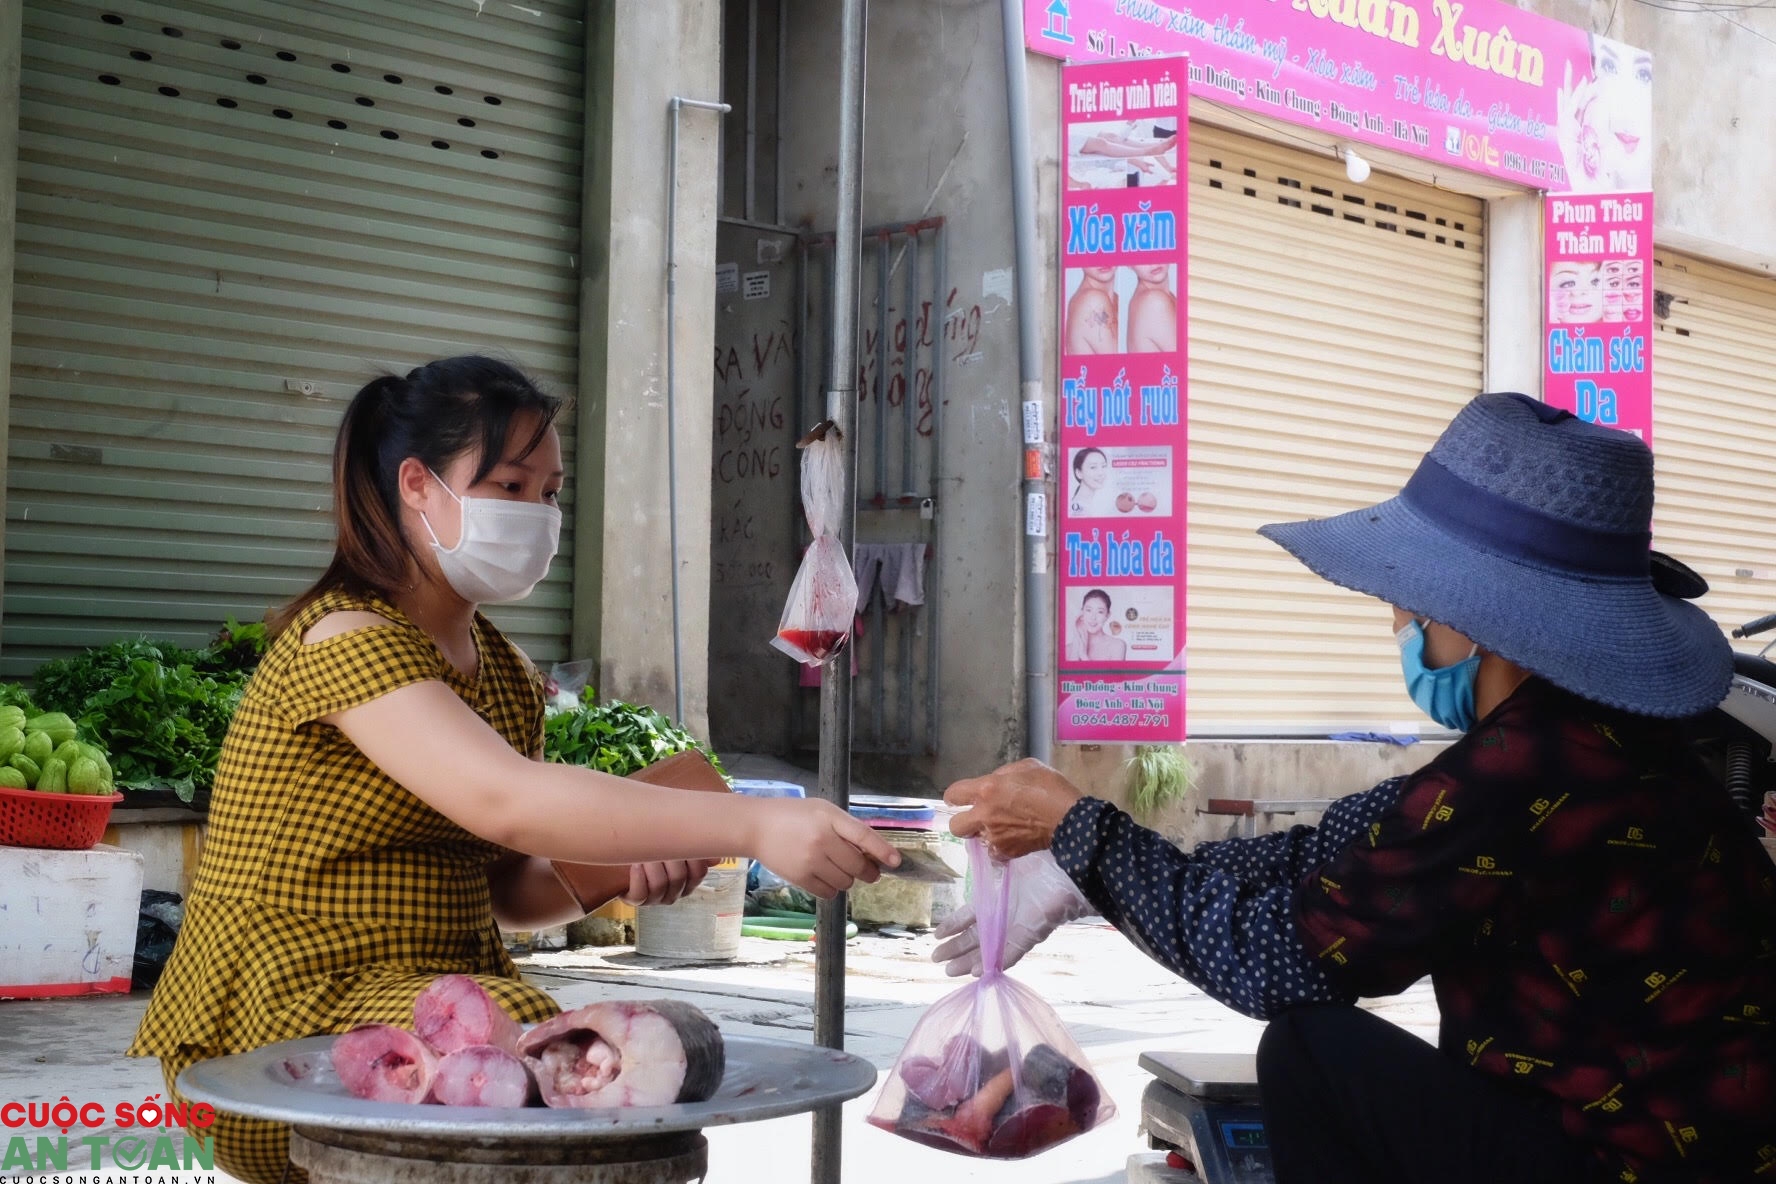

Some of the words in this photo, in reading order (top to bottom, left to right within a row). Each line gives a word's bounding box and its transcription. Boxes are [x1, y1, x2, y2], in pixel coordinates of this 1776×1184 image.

[1088, 30, 1105, 53] Số
[1167, 7, 1208, 39] xăm
[1213, 14, 1256, 54] thẩm
[1262, 37, 1287, 77] mỹ
[1305, 48, 1337, 79] Xóa
[1340, 61, 1377, 91] xăm
[1430, 0, 1544, 87] Xuân
[1069, 82, 1097, 118] Triệt
[1100, 81, 1124, 116] lông
[1256, 80, 1281, 104] Kim
[1284, 88, 1321, 118] Chung
[1364, 110, 1385, 133] Anh
[1394, 119, 1409, 140] Hà
[1411, 124, 1430, 148] Nội
[1068, 203, 1116, 255] Xóa
[1122, 201, 1177, 252] xăm
[1552, 200, 1596, 224] Phun
[1600, 198, 1643, 223] Thêu
[1556, 226, 1604, 254] Thẩm
[1609, 230, 1637, 256] Mỹ
[1549, 327, 1604, 373] Chăm
[1610, 326, 1644, 373] sóc
[1063, 366, 1097, 436] Tẩy
[1101, 367, 1132, 427] nốt
[1140, 365, 1179, 426] ruồi
[1575, 380, 1618, 425] Da
[1066, 528, 1101, 577] Trẻ
[1106, 529, 1144, 577] hóa
[1150, 530, 1175, 577] da
[1104, 698, 1122, 709] Anh
[1147, 681, 1178, 695] Chung
[1072, 713, 1169, 727] 0964.487.791
